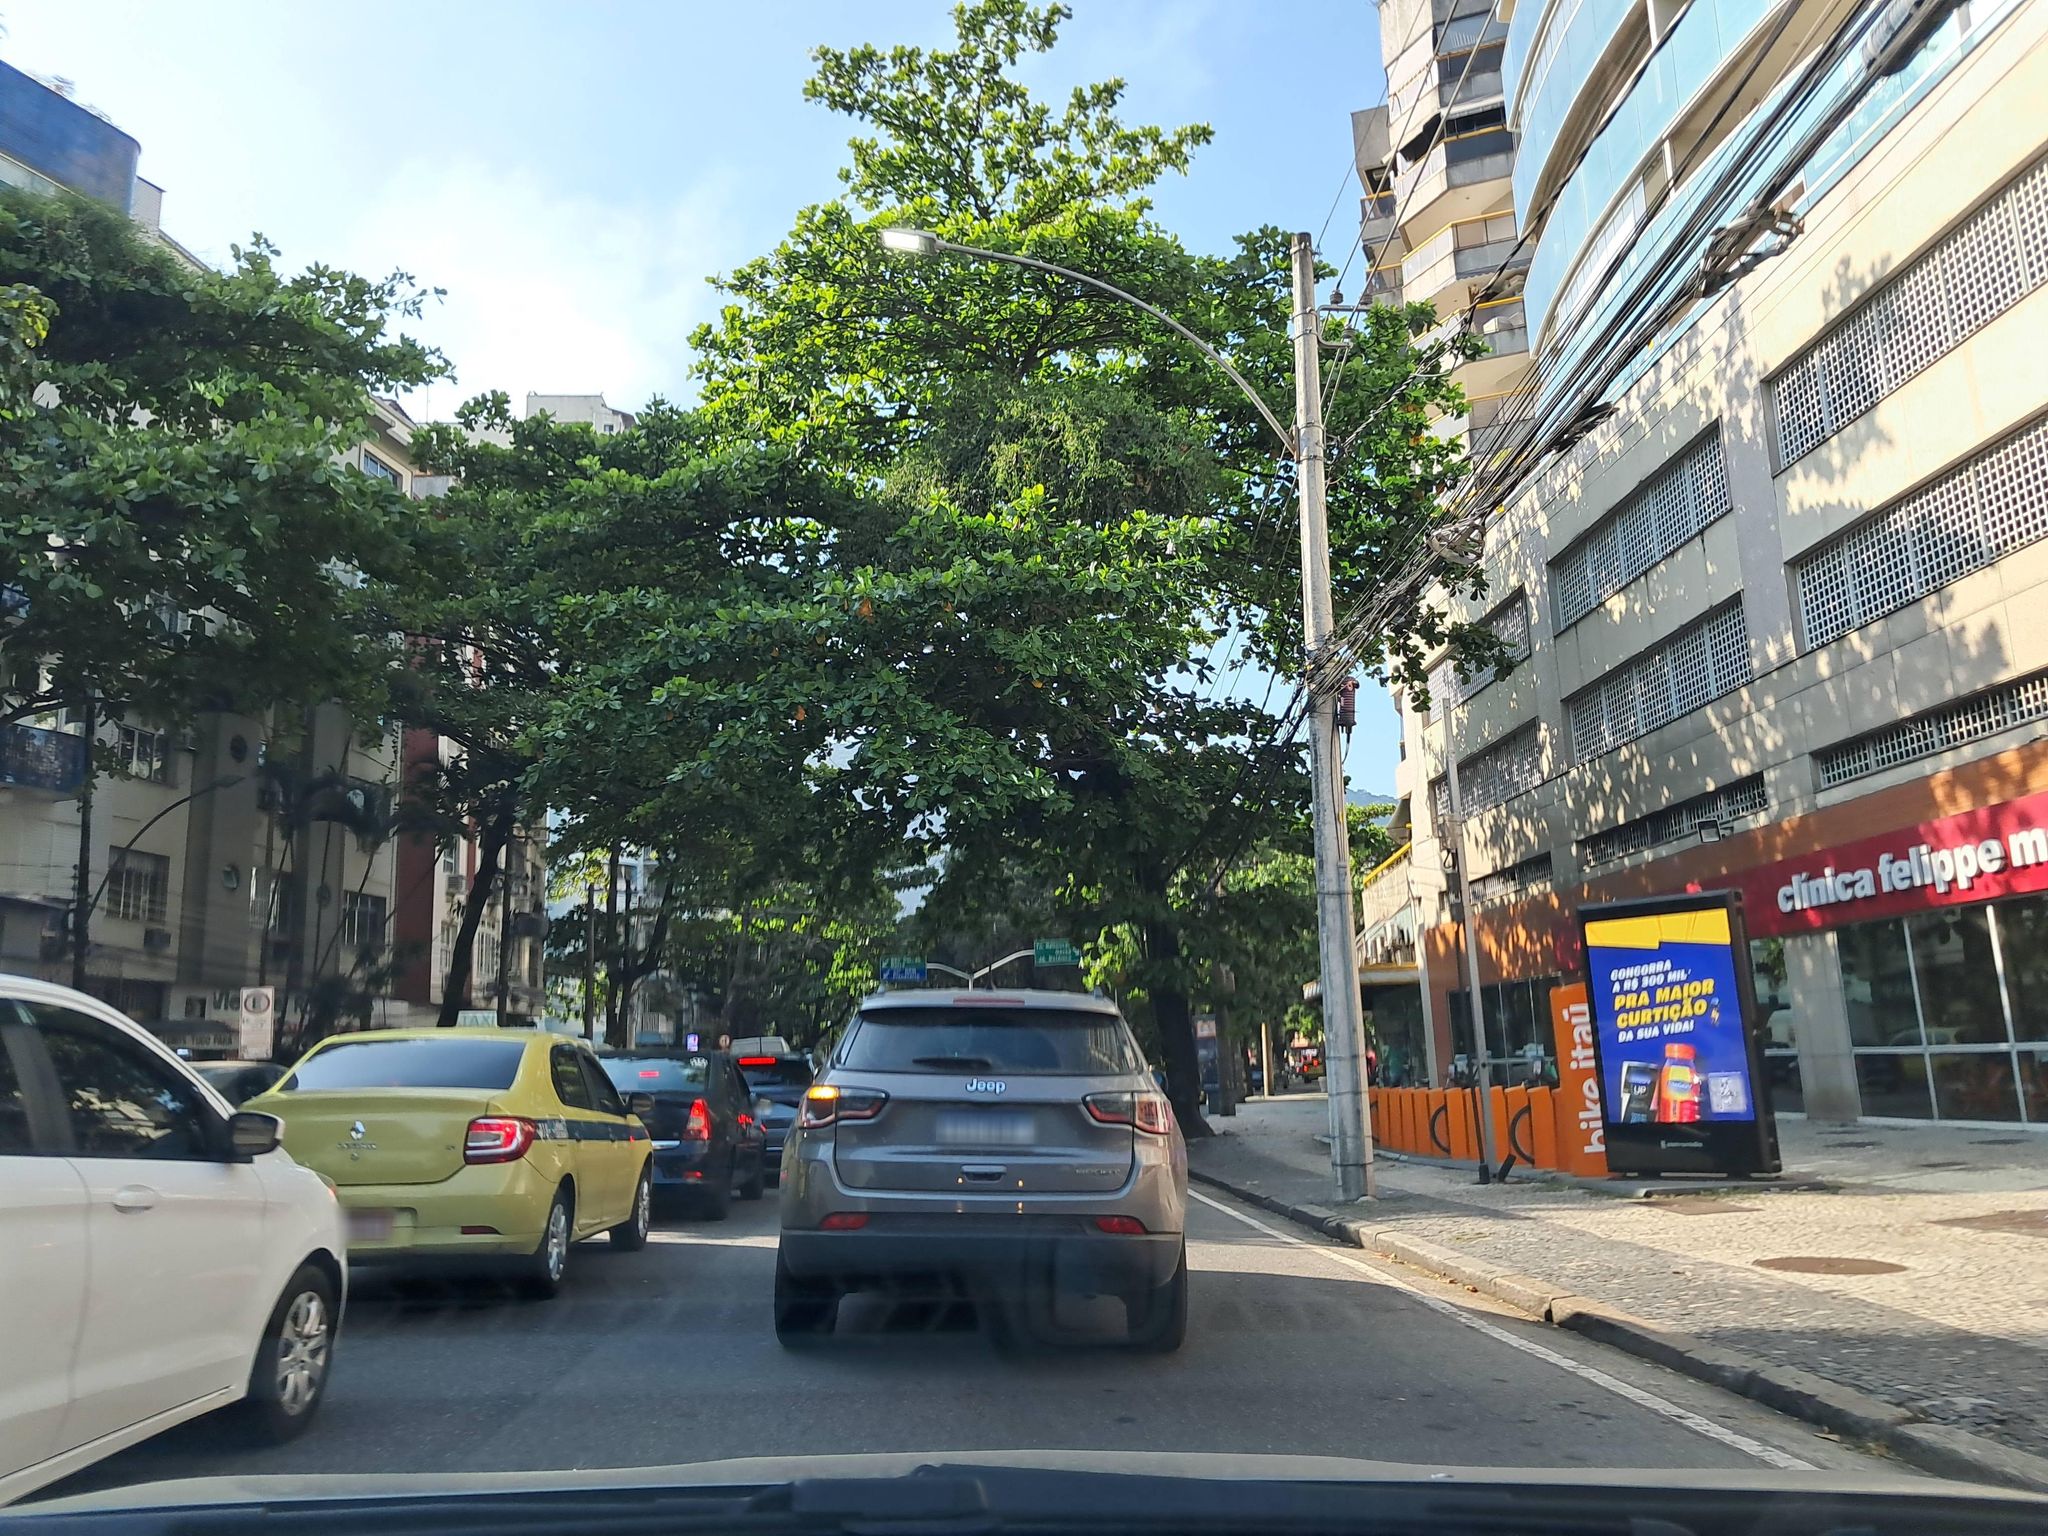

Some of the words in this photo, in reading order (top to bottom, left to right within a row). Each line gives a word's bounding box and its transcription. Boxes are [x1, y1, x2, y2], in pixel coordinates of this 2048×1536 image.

[1777, 867, 1876, 913] clínica
[1878, 839, 2006, 893] felippe
[1611, 959, 1672, 981] CONCORRA
[1612, 981, 1620, 994] A
[1614, 991, 1649, 1011] PRA
[1656, 978, 1715, 1004] MAIOR
[461, 1015, 496, 1027] TAXI
[1616, 996, 1708, 1029] CURTIÇÃO
[1618, 1029, 1634, 1043] DA
[1636, 1026, 1660, 1040] SUA
[966, 1078, 1006, 1095] Jeep
[1578, 1077, 1606, 1153] bike
